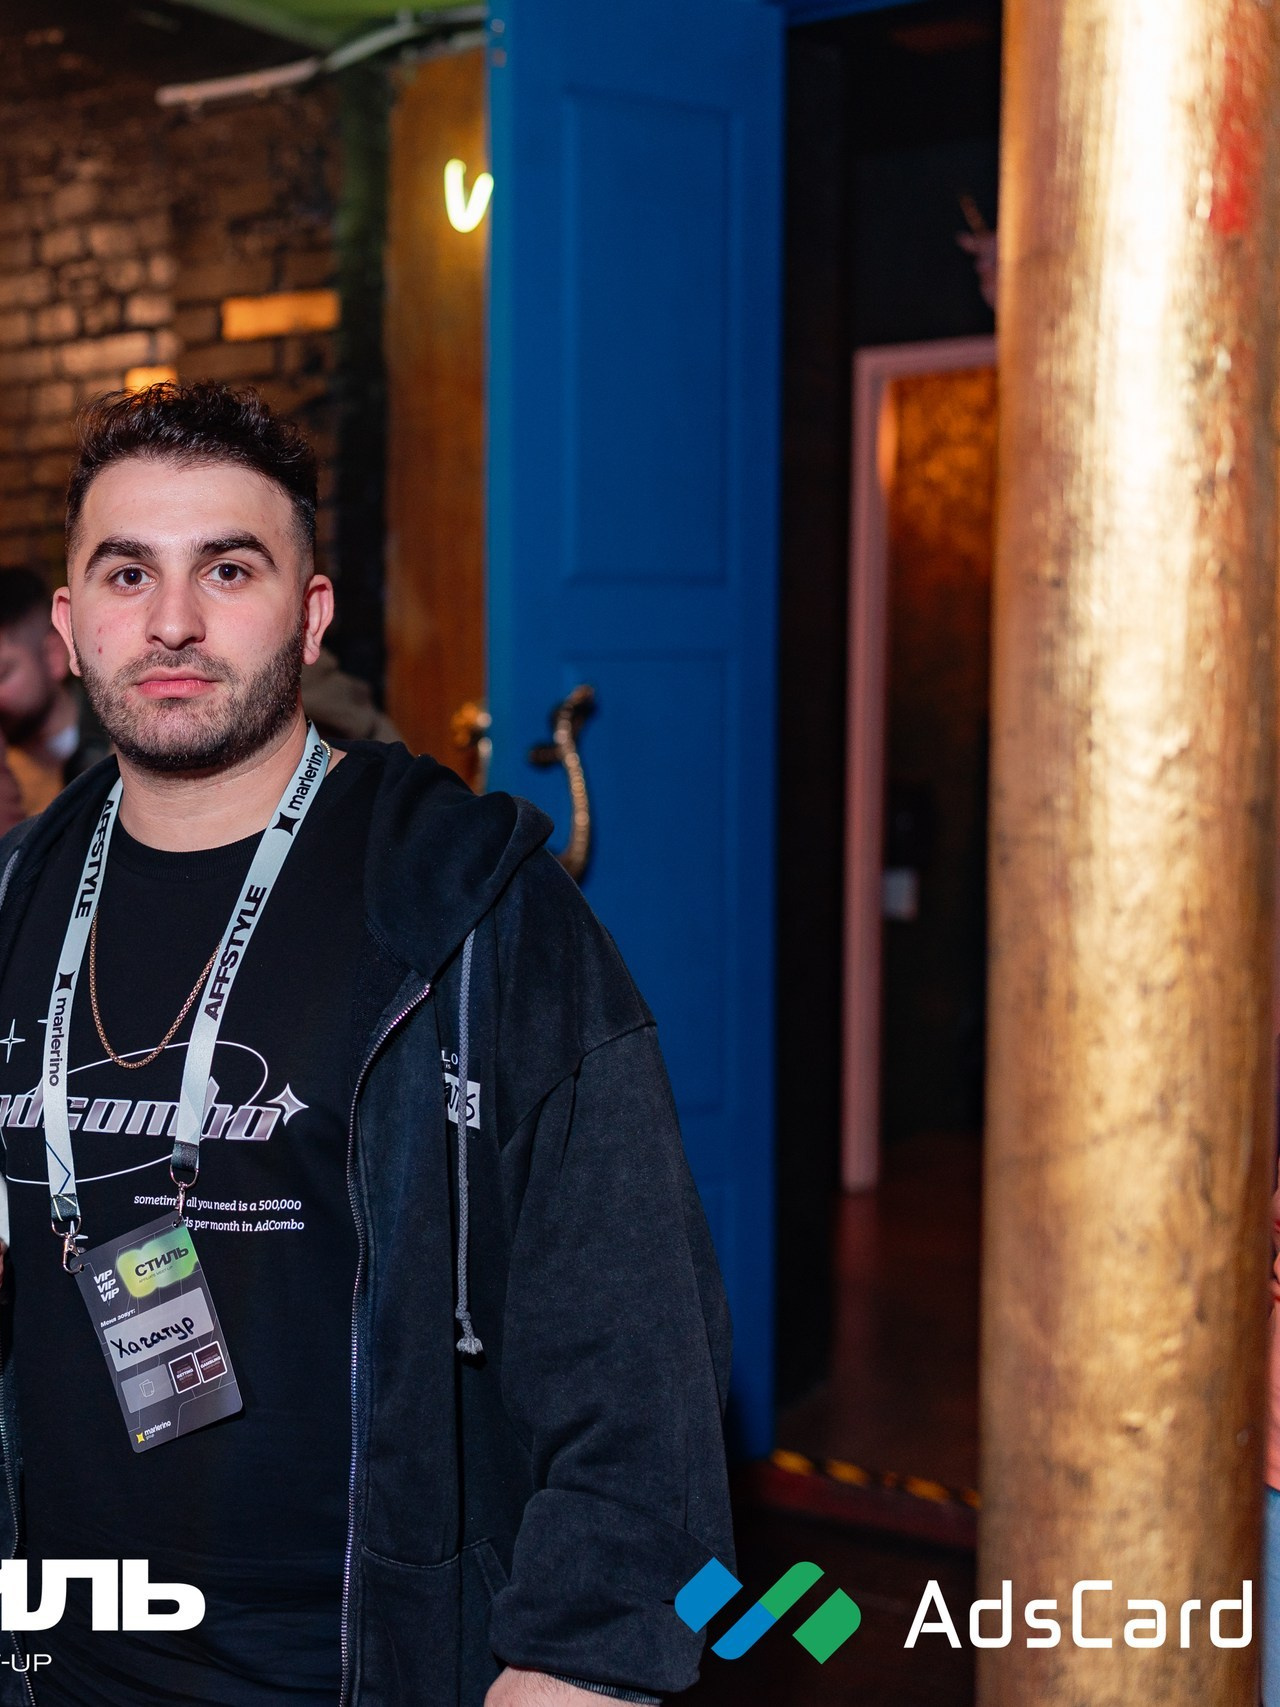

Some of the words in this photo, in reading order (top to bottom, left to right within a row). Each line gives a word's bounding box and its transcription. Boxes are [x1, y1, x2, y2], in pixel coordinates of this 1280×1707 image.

[287, 743, 322, 811] marlerino
[75, 799, 115, 920] AFFSTYLE
[203, 884, 268, 1022] AFFSTYLE
[49, 997, 67, 1087] marlerino
[186, 1197, 198, 1208] all
[197, 1200, 214, 1211] you
[213, 1200, 237, 1212] need
[238, 1201, 248, 1212] is
[249, 1202, 257, 1212] a
[258, 1199, 302, 1212] 500,000
[194, 1219, 210, 1231] per
[210, 1221, 240, 1232] month
[241, 1221, 253, 1232] in
[254, 1219, 305, 1232] AdCombo
[135, 1247, 189, 1277] СТИЛЬ
[93, 1269, 113, 1284] VIP
[97, 1278, 116, 1293] VIP
[100, 1287, 120, 1302] VIP
[144, 1420, 172, 1436] marlerino
